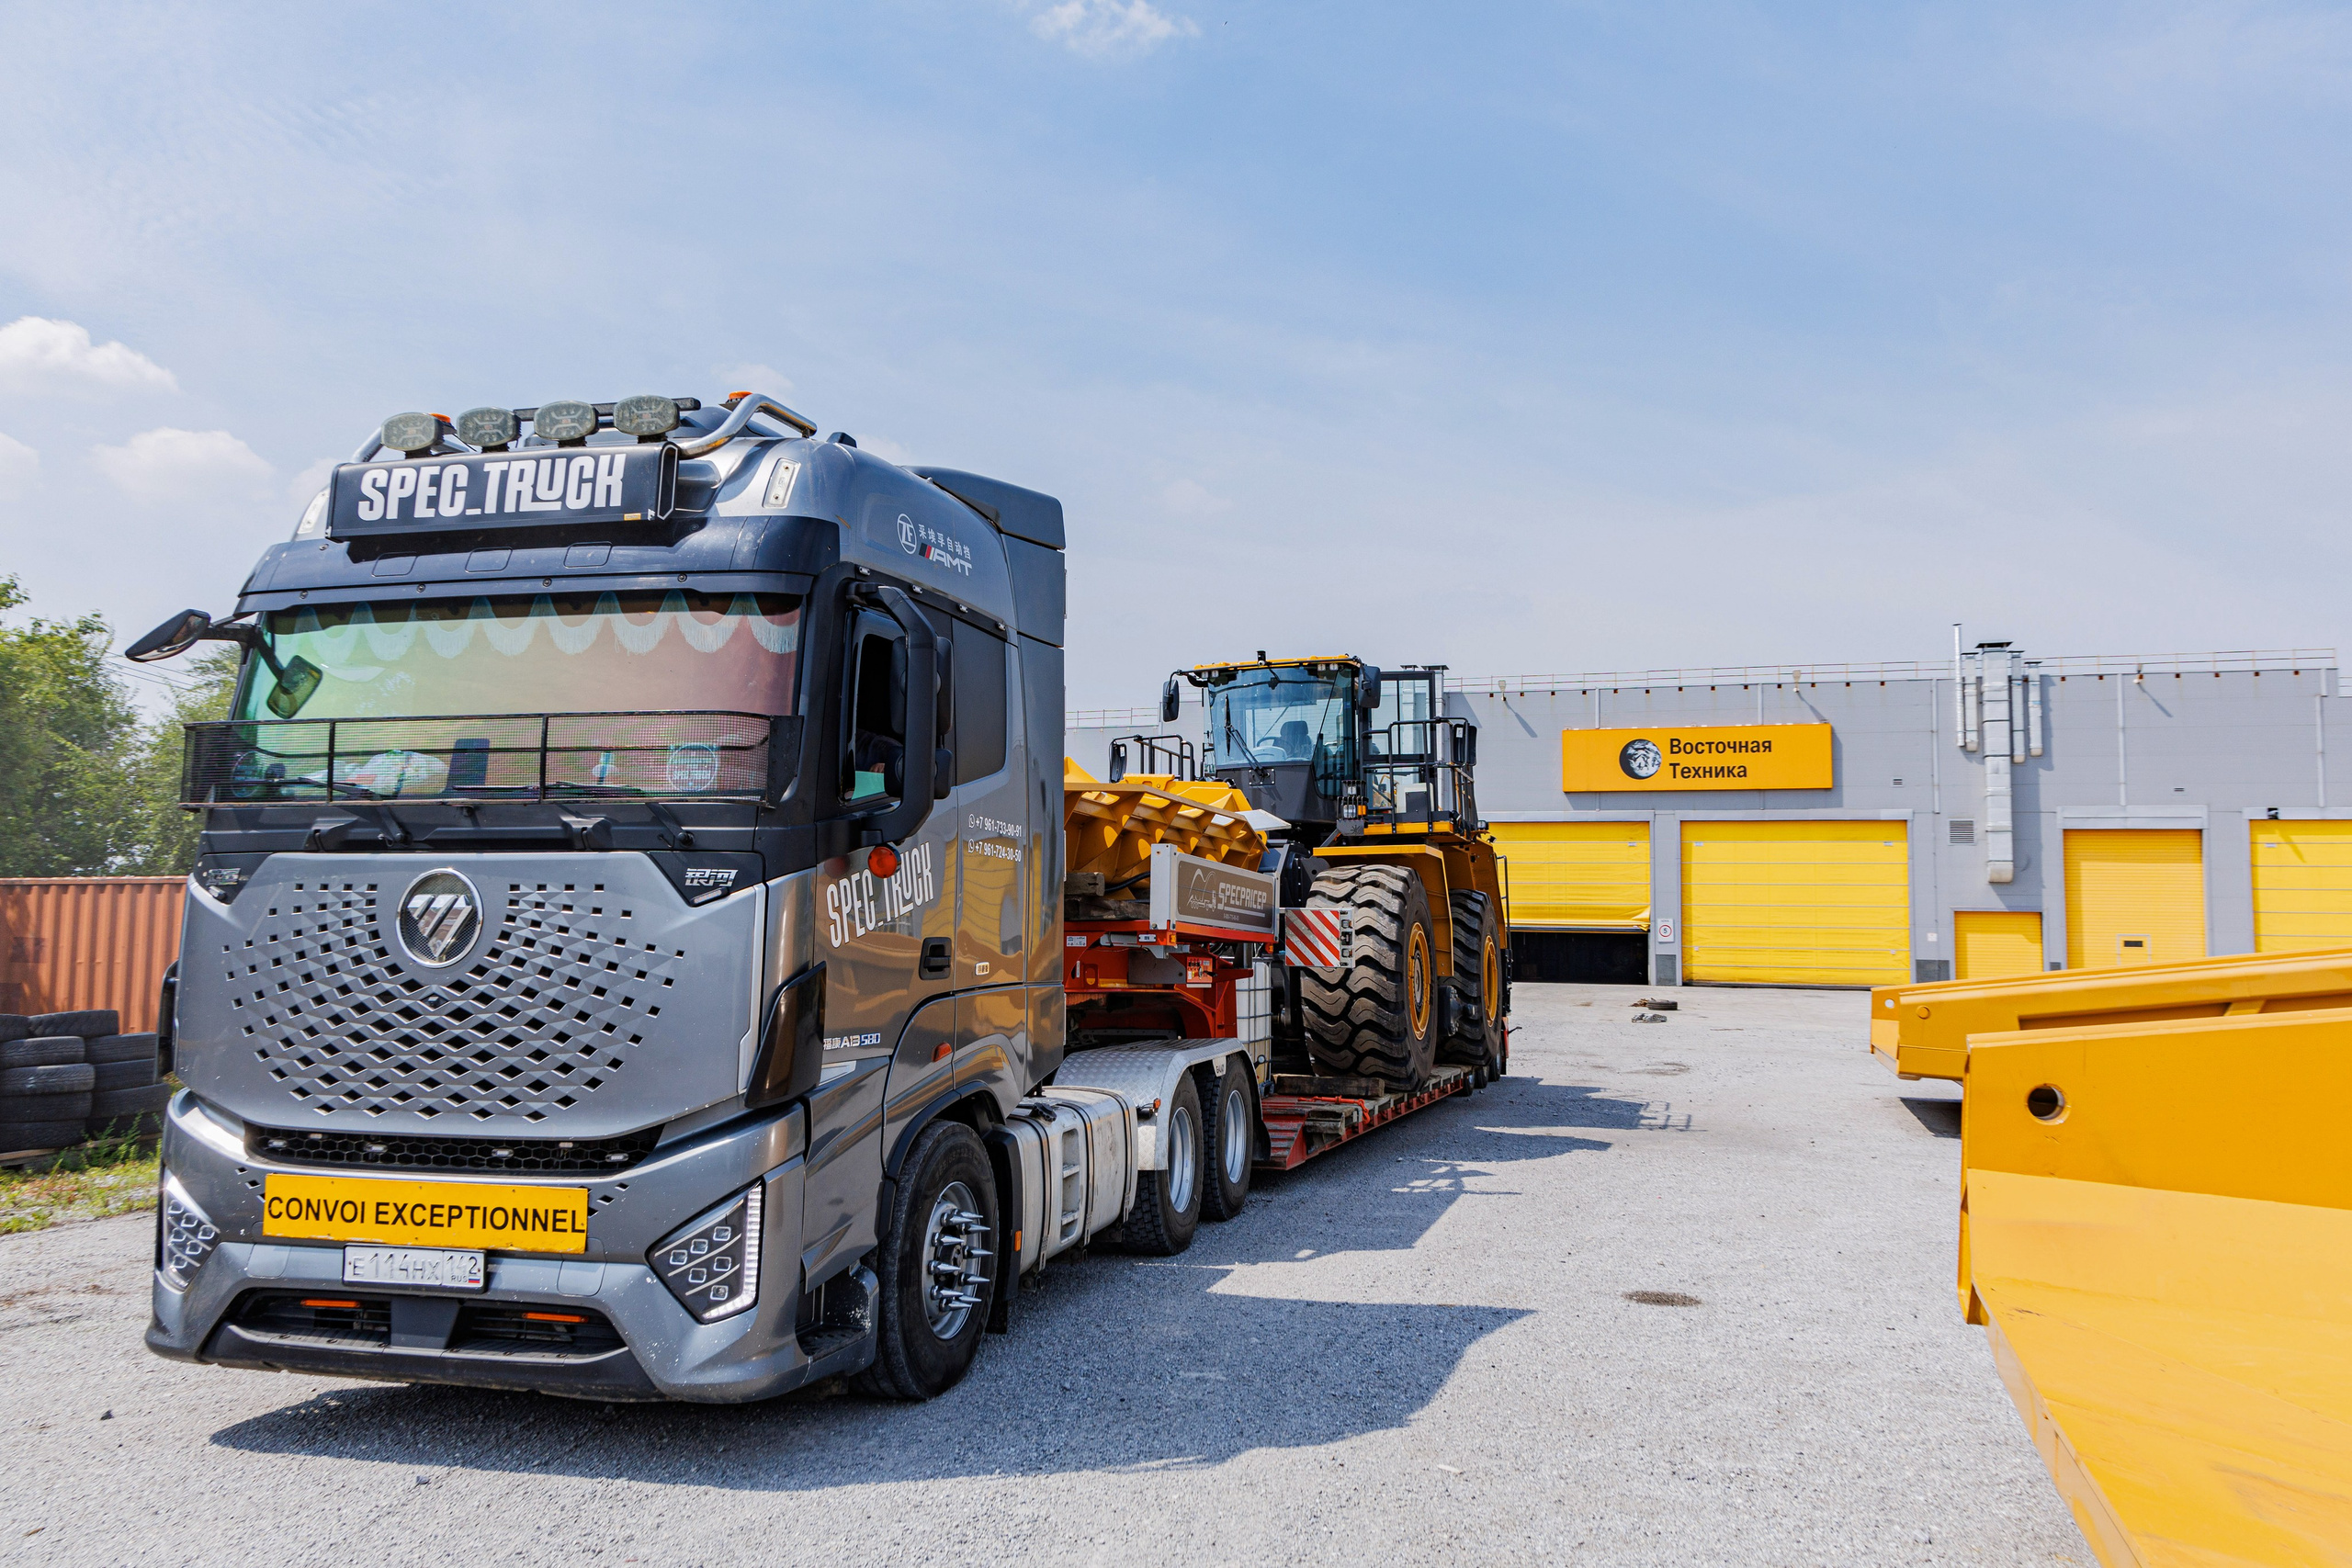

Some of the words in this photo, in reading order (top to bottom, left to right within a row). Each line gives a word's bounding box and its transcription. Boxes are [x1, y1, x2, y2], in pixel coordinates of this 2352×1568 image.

[357, 453, 627, 521] SPEC_TRUCK
[1669, 738, 1772, 755] Восточная
[1669, 762, 1747, 779] Техника
[976, 816, 983, 829] +7
[984, 818, 1022, 837] 961-733-90-91
[975, 841, 982, 854] +7
[984, 842, 1022, 862] 961-724-30-50
[267, 1196, 366, 1224] CONVOI
[374, 1201, 586, 1234] EXCEPTIONNEL
[450, 1274, 468, 1282] RUS
